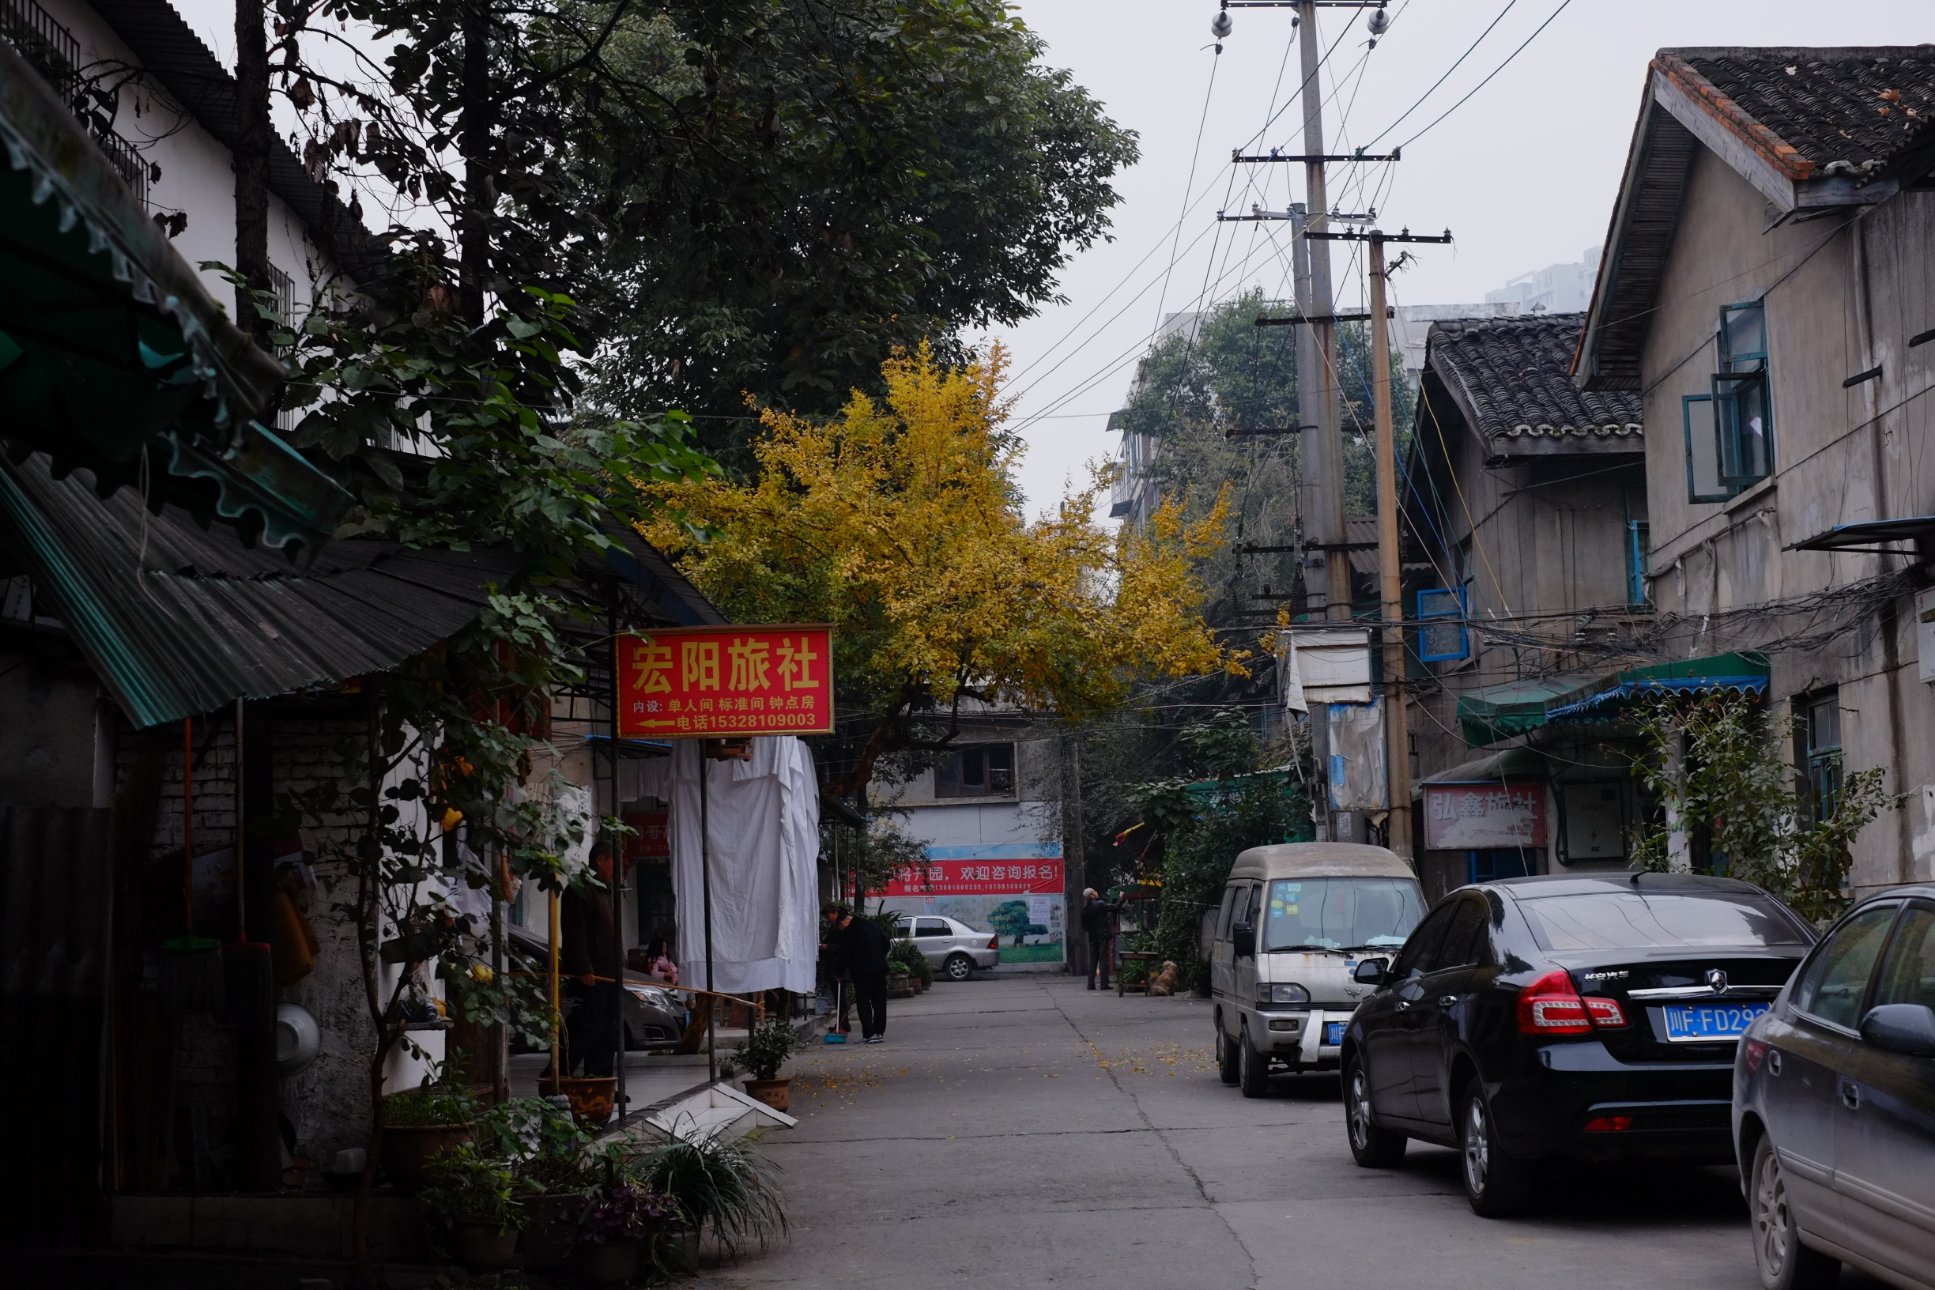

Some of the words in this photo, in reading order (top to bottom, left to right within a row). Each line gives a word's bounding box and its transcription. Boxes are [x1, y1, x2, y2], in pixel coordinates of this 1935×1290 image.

[632, 637, 819, 694] 宏阳旅社
[668, 699, 713, 713] 单人间
[718, 697, 764, 712] 标准间
[769, 696, 815, 710] 钟点房
[677, 713, 816, 730] 电话15328109003
